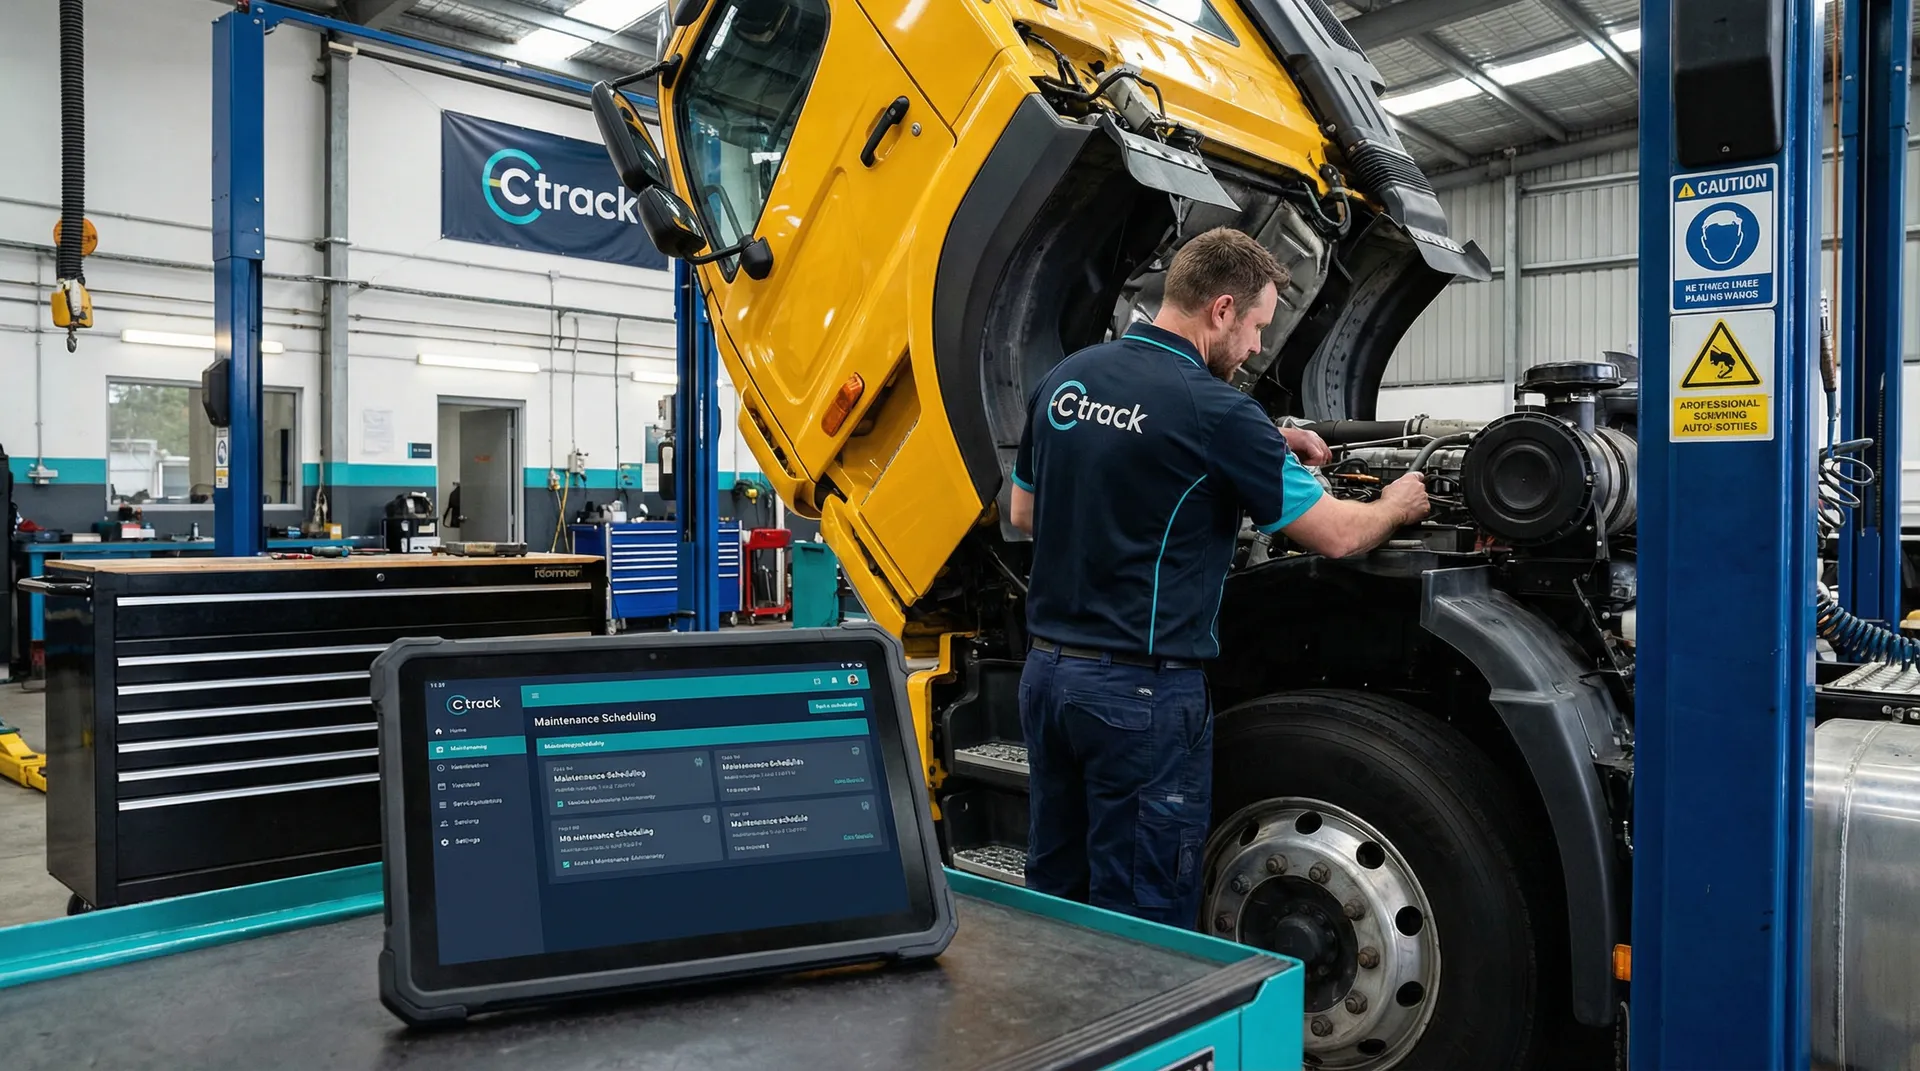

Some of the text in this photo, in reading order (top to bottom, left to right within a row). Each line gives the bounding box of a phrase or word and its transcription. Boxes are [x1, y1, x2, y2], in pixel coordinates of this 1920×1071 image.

[1697, 173, 1767, 195] CAUTION
[498, 167, 638, 225] Ctrack
[1056, 391, 1148, 434] Ctrack
[451, 696, 501, 711] Ctrack
[534, 711, 657, 727] Maintenance Scheduling
